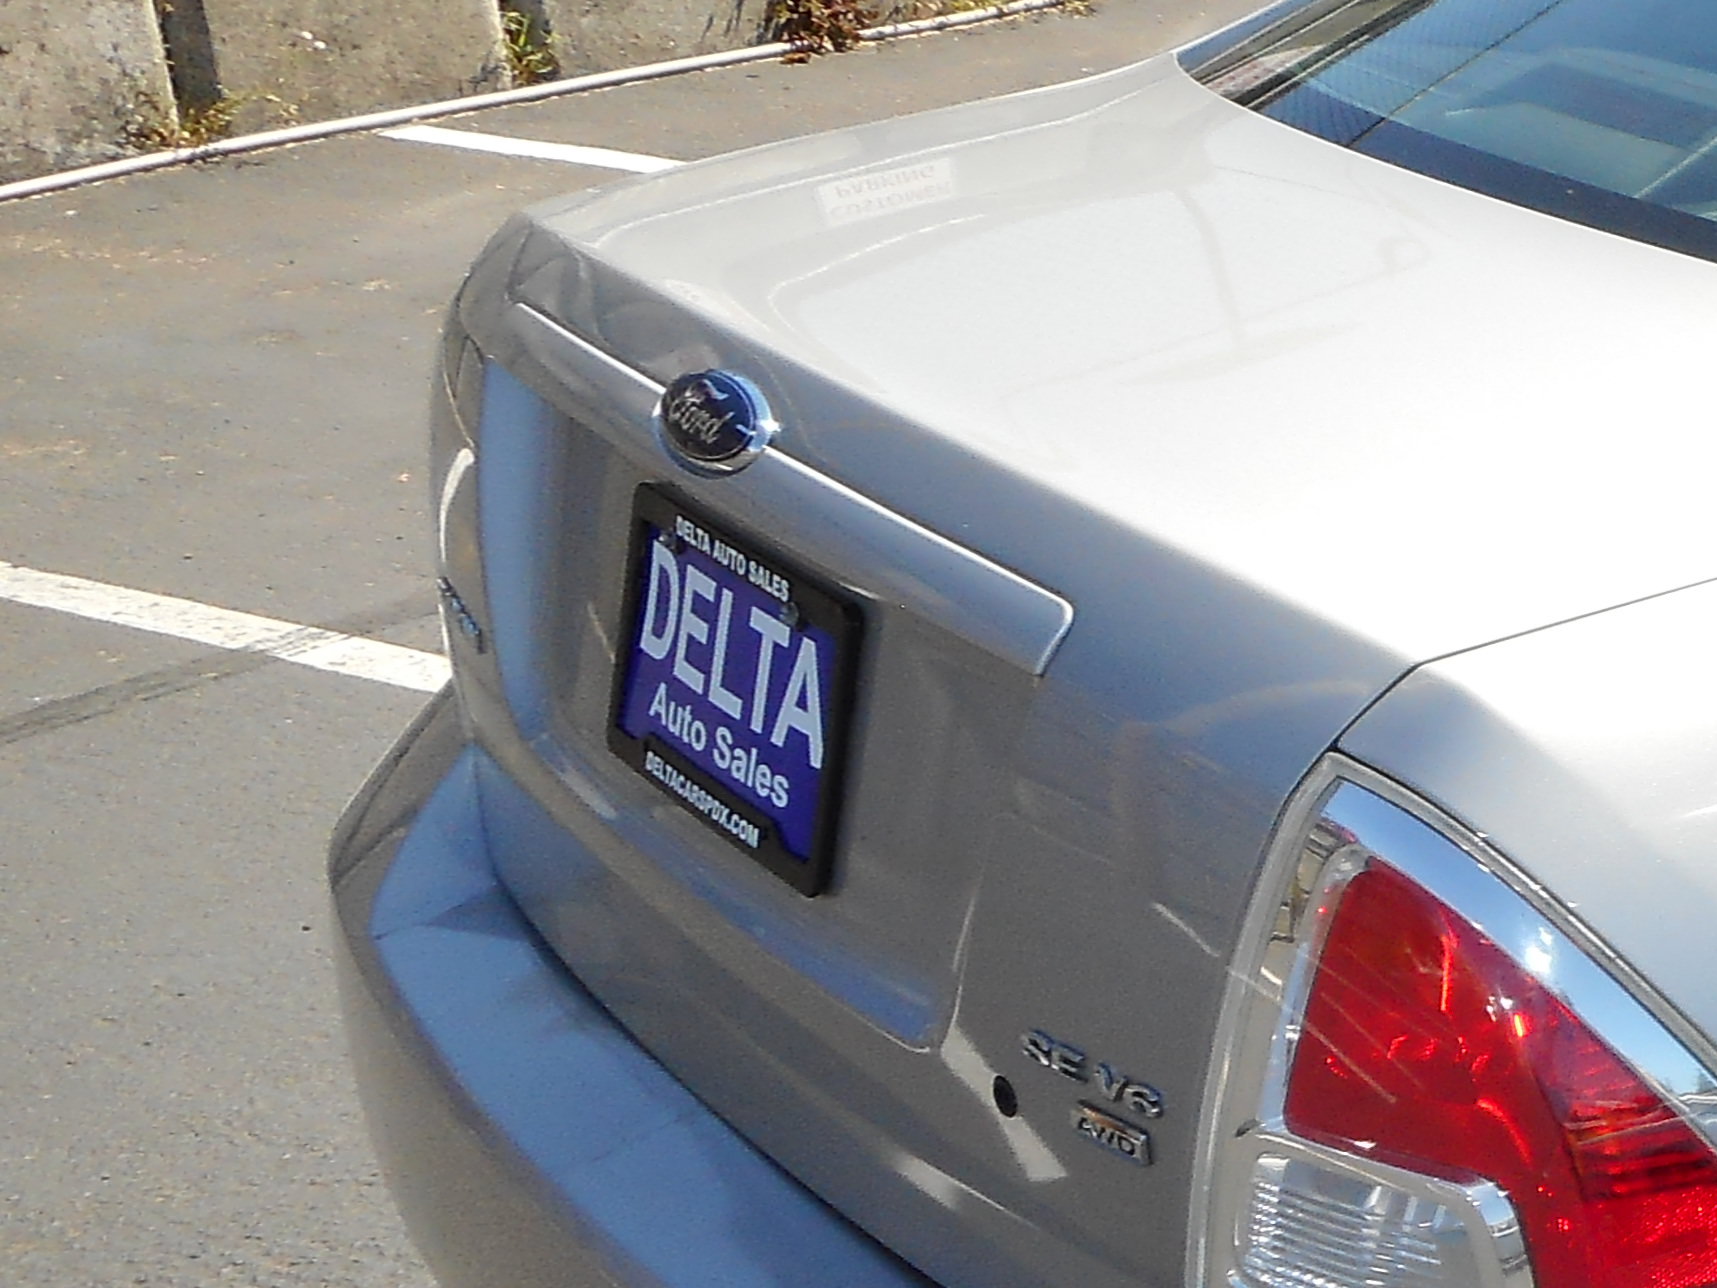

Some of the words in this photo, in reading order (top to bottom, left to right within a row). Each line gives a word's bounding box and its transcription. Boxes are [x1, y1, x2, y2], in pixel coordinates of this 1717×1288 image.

[668, 380, 735, 444] Ford
[676, 515, 711, 555] DELTA
[712, 539, 747, 575] AUTO
[748, 560, 790, 602] SALES
[639, 539, 824, 769] DELTA
[649, 682, 707, 751] Auto
[713, 726, 789, 808] Sales
[645, 750, 760, 849] DELTACARSPDX.COM
[1022, 1029, 1088, 1084] SE
[1095, 1061, 1165, 1119] V6
